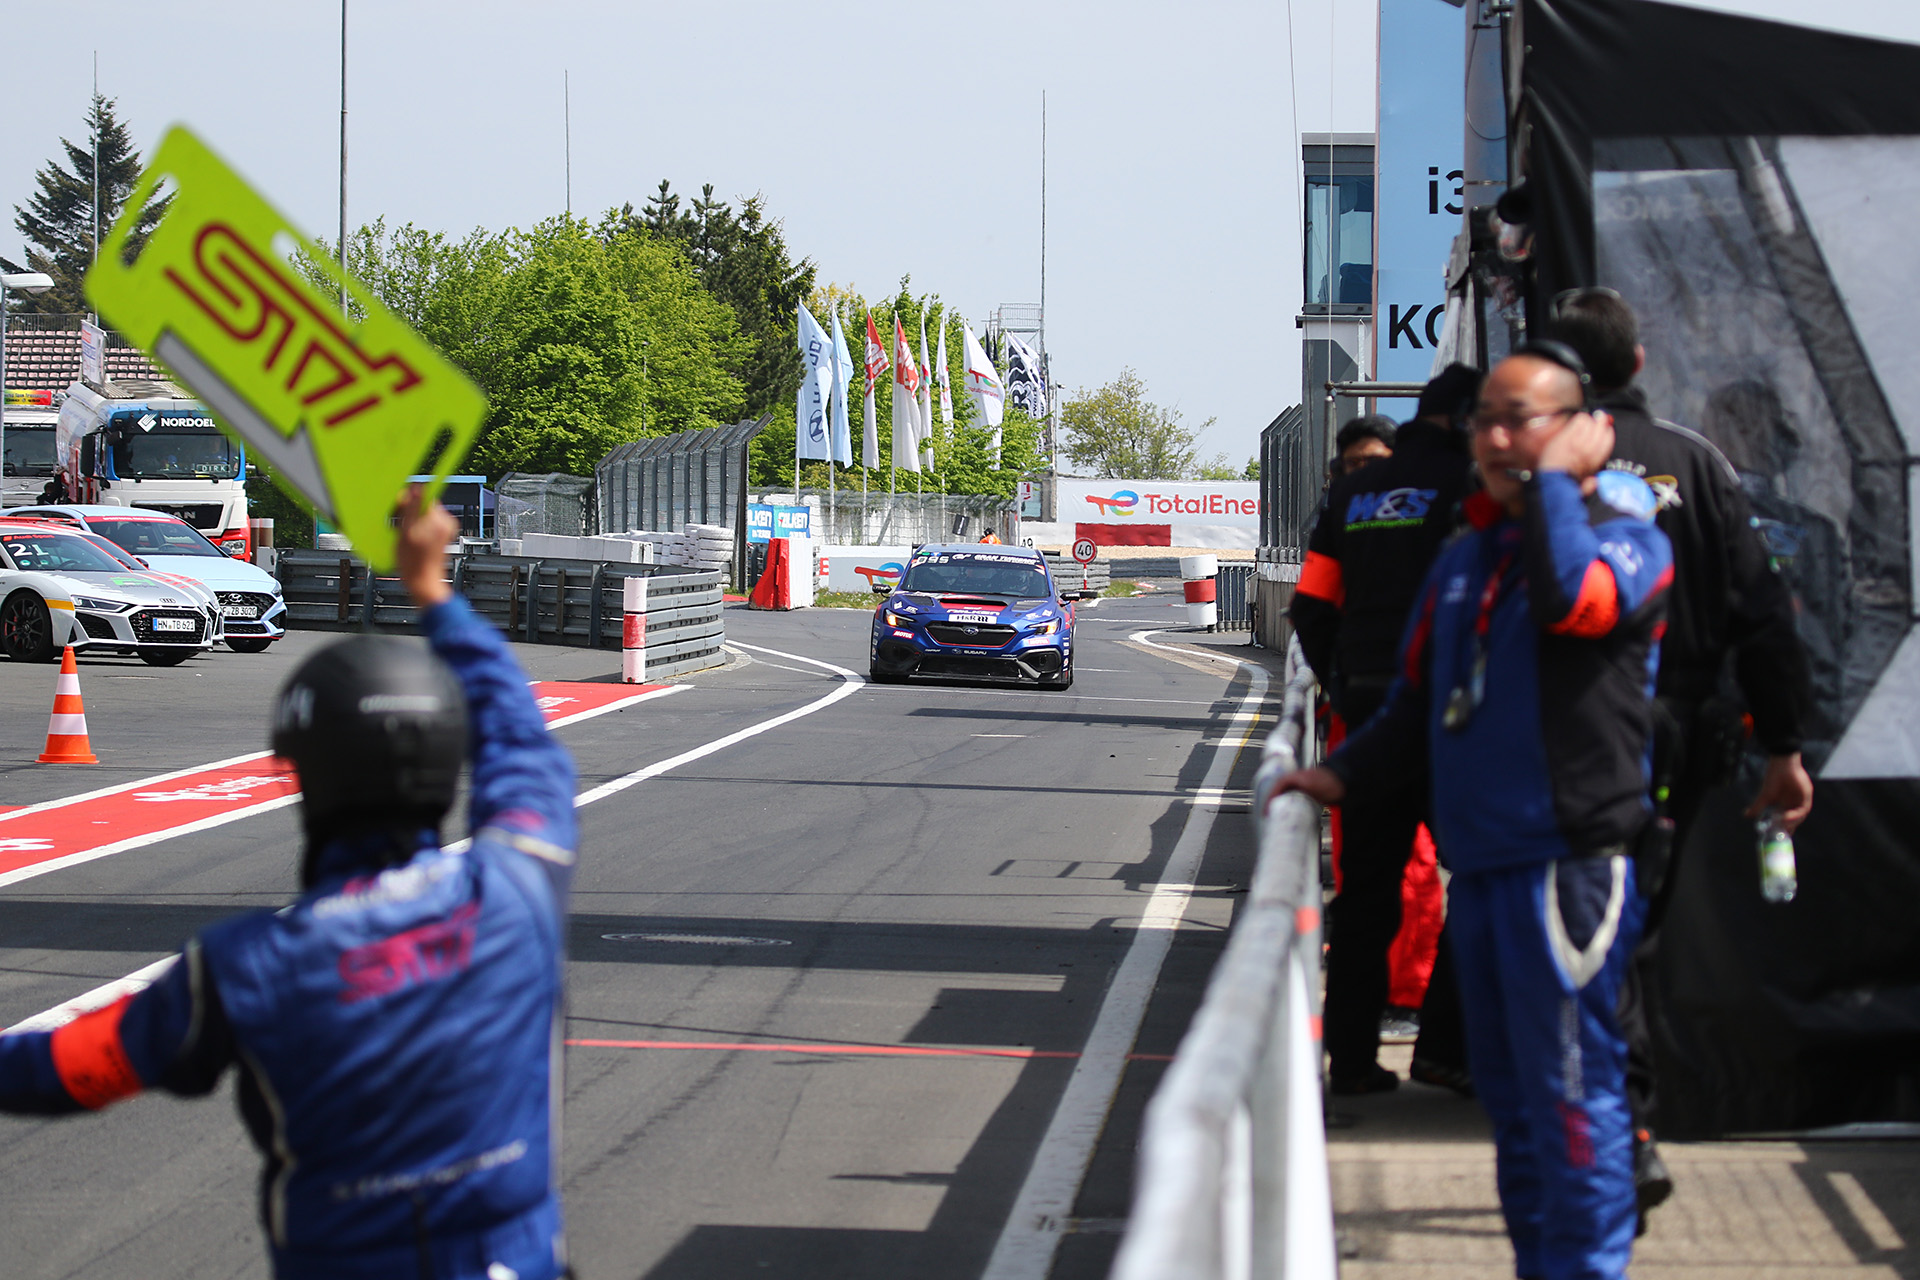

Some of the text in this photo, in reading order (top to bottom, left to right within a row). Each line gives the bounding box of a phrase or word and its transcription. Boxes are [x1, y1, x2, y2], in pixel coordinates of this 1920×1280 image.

[160, 417, 216, 428] NORDOEL
[201, 464, 226, 473] DIRK
[170, 510, 196, 520] AN
[7, 543, 49, 557] 21
[1077, 543, 1092, 557] 40
[157, 620, 168, 628] HN
[182, 621, 195, 630] 621
[893, 630, 913, 639] MOTUL
